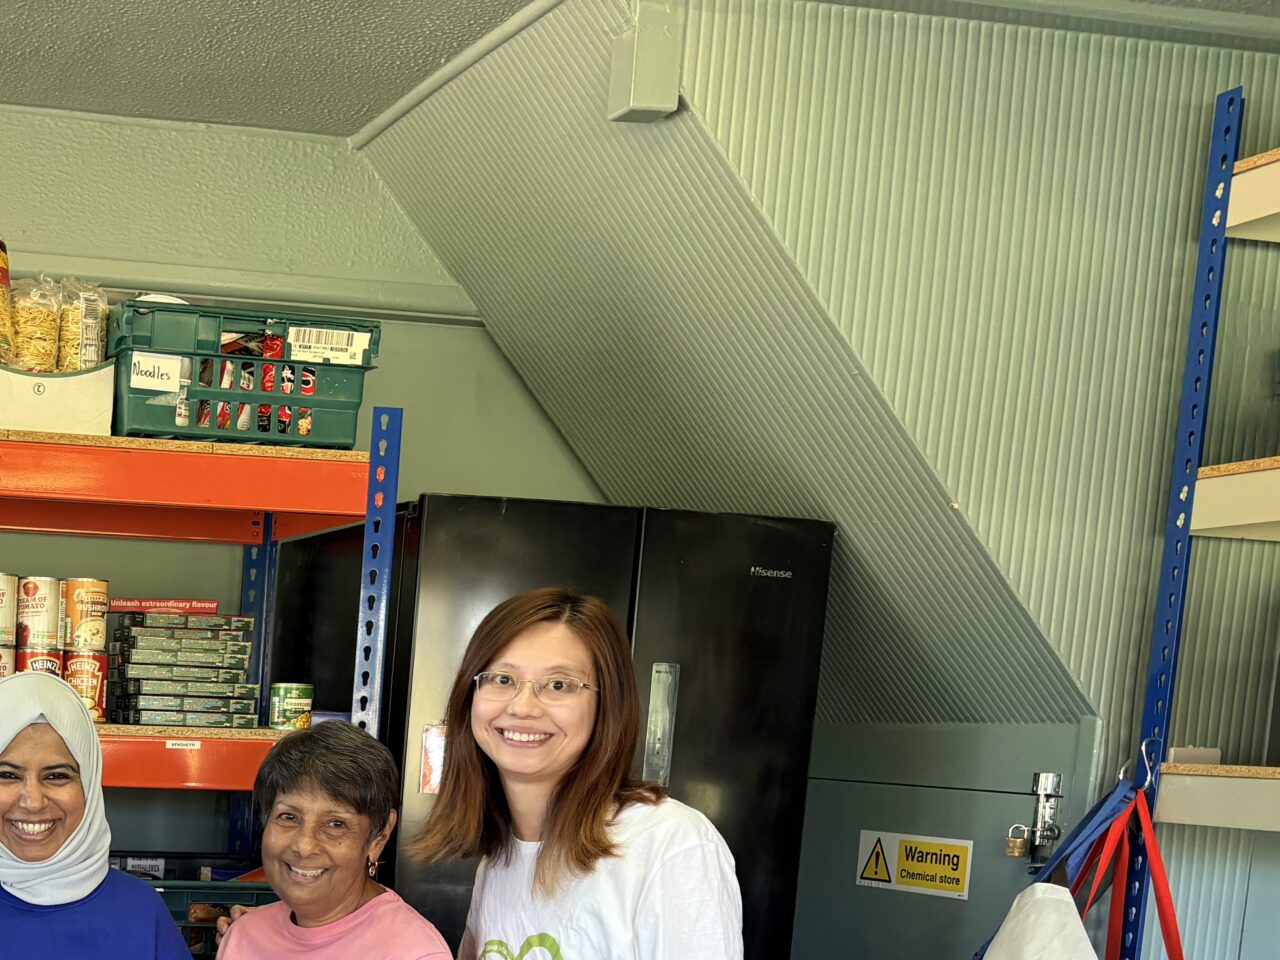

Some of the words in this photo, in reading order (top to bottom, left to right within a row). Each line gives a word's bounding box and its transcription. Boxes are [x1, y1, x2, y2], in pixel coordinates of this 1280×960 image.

[132, 360, 170, 382] Noodles
[750, 566, 792, 578] Hisense
[142, 600, 190, 609] extraordinary
[33, 661, 56, 671] HEINZ
[70, 663, 95, 672] HEINZ
[68, 678, 97, 686] CHICKEN
[904, 845, 960, 872] Warning
[900, 869, 937, 883] Chemical
[939, 875, 960, 885] store
